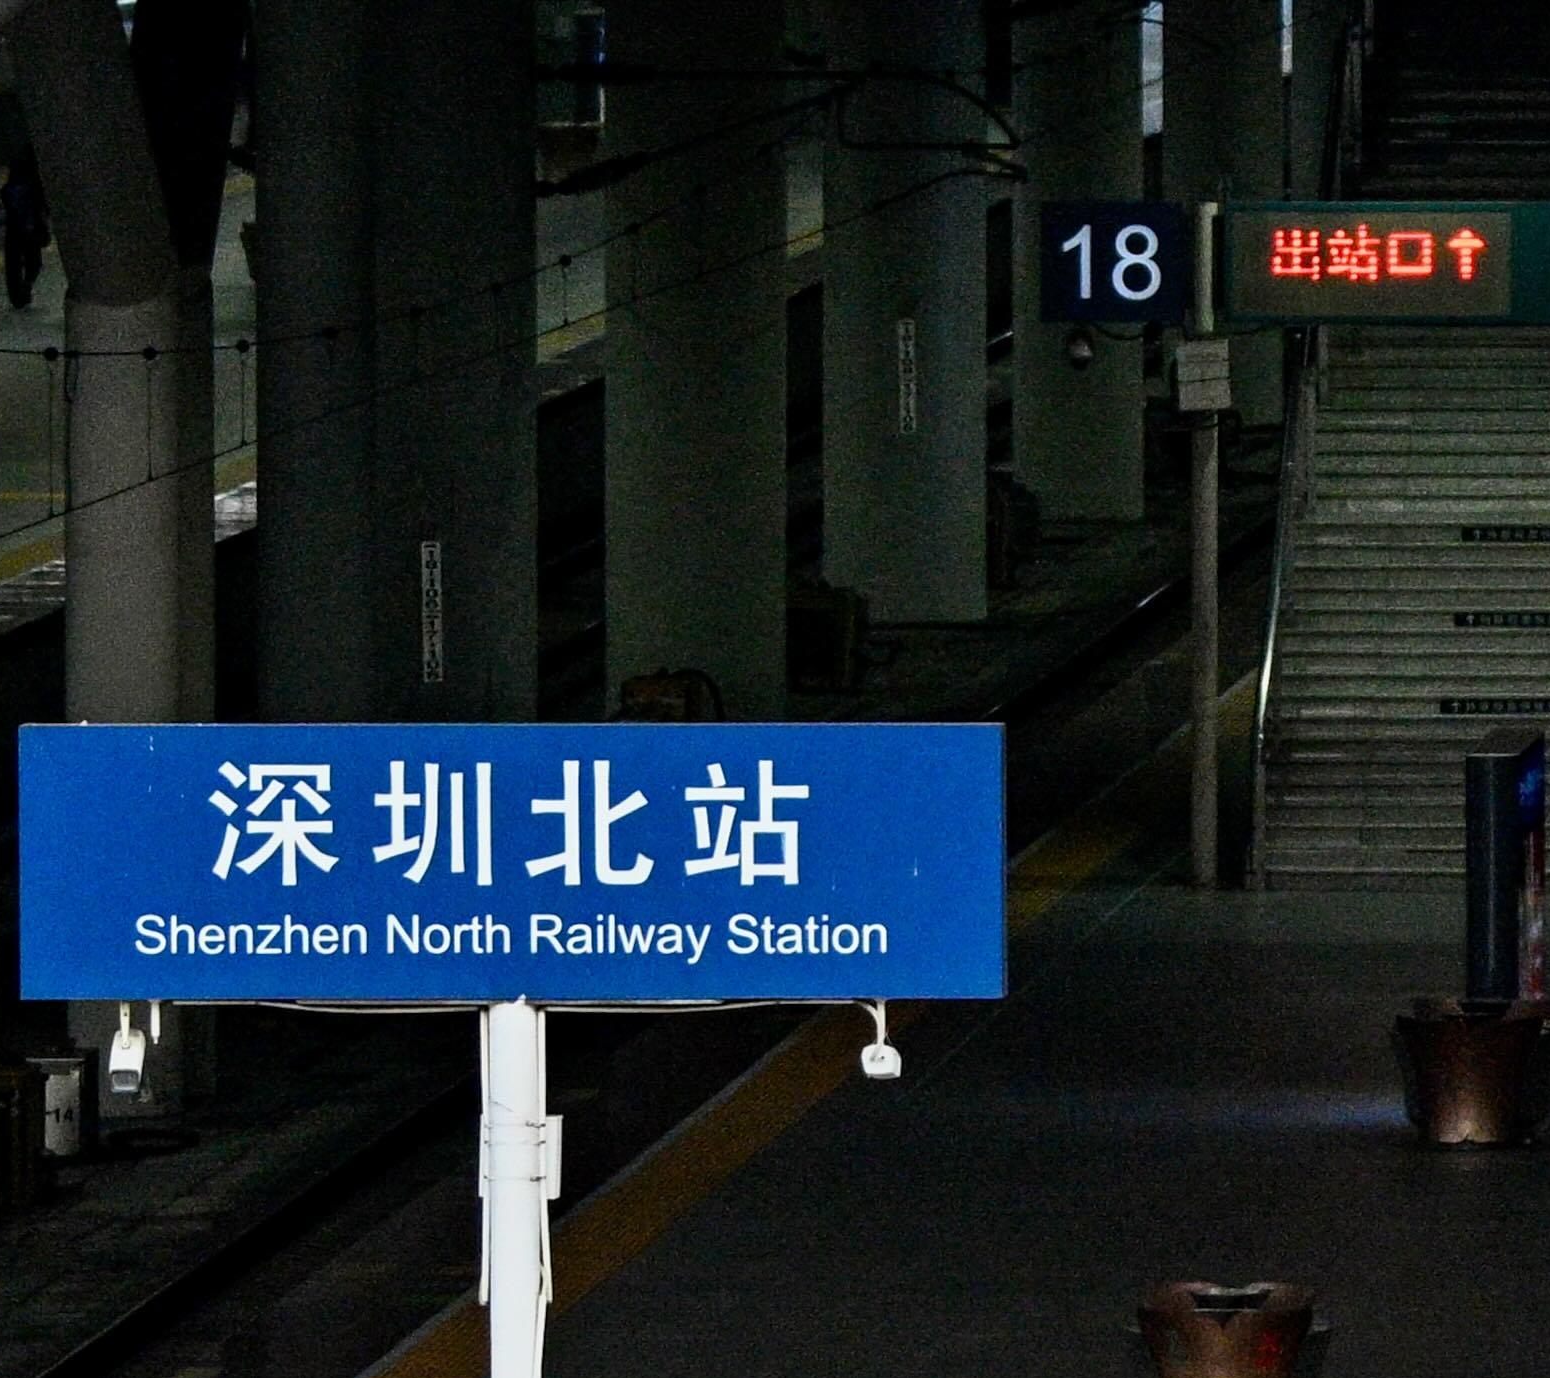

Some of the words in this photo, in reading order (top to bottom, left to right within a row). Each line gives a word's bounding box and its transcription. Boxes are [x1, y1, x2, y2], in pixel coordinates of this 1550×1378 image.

[1063, 225, 1161, 300] 18
[1270, 224, 1435, 281] 出站口
[209, 760, 810, 887] 深圳北站
[135, 914, 367, 955] Shenzhen
[387, 914, 511, 954] North
[530, 914, 711, 964] Railway
[727, 913, 887, 955] Station
